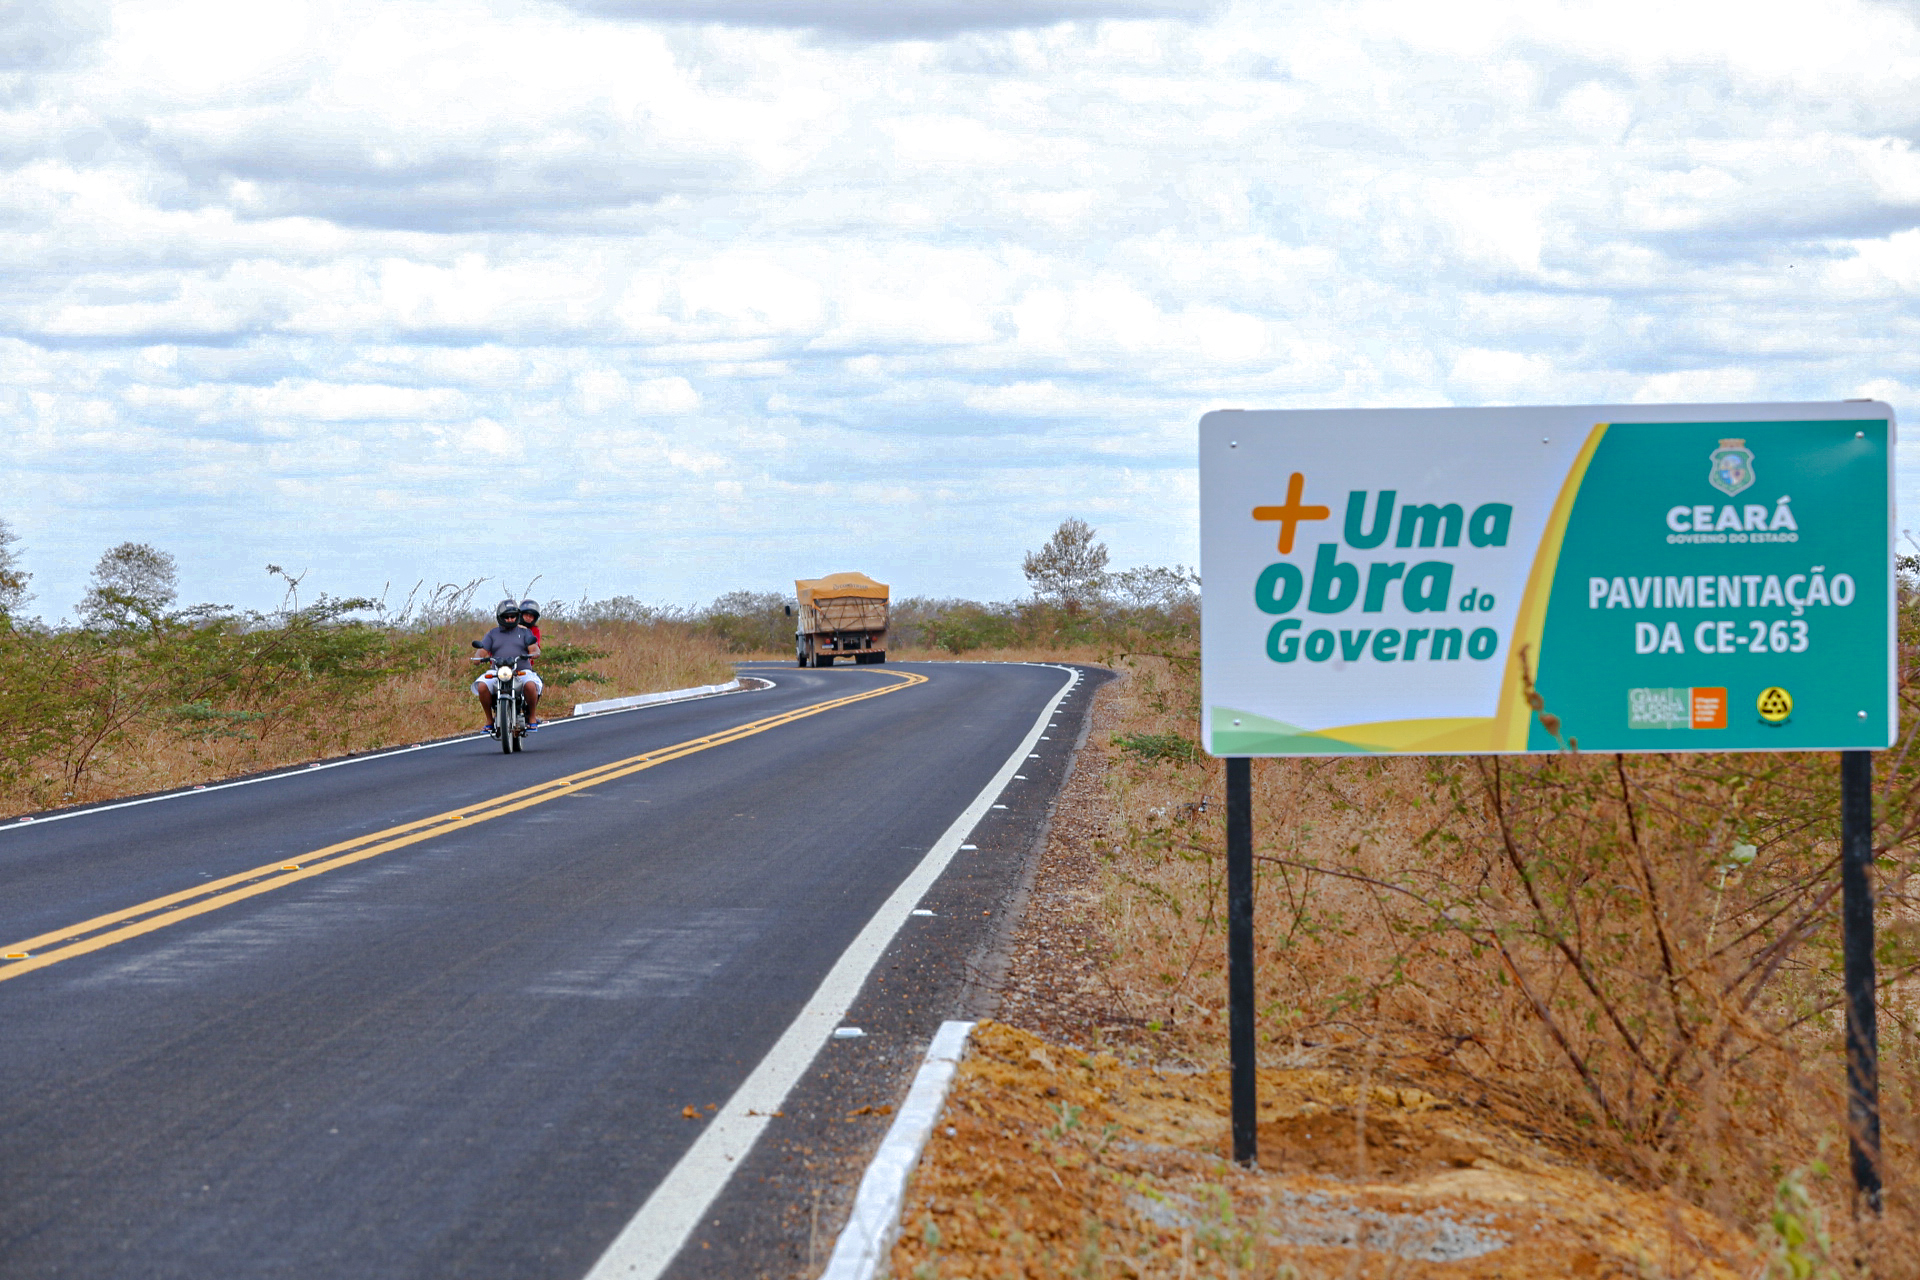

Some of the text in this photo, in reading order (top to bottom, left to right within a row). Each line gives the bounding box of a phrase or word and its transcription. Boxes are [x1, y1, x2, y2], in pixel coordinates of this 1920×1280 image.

[1344, 490, 1513, 549] Uma
[1666, 495, 1798, 532] CEARÁ
[1666, 532, 1799, 545] GOVERNO DO ESTADO
[1255, 543, 1495, 614] obra do
[1588, 565, 1856, 616] PAVIMENTAÇÃO
[1266, 618, 1498, 663] Governo
[1635, 620, 1809, 654] DA CE-263
